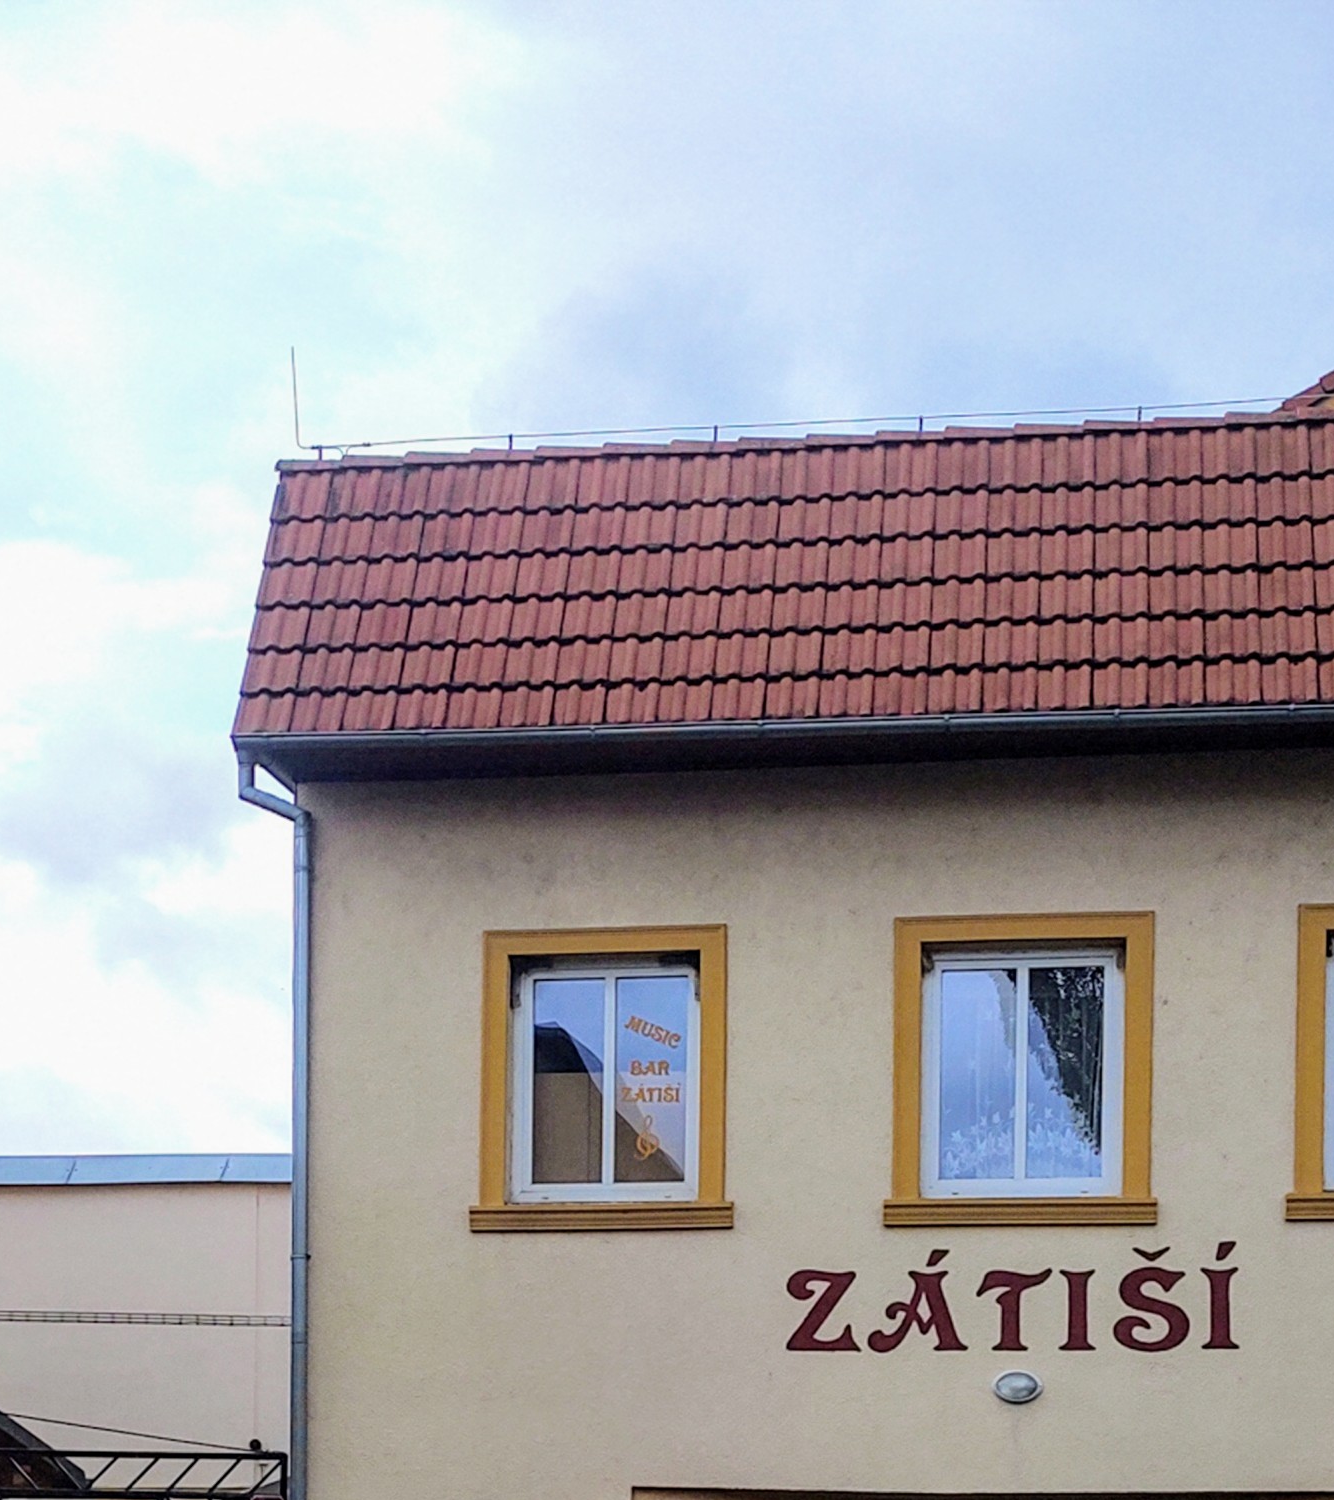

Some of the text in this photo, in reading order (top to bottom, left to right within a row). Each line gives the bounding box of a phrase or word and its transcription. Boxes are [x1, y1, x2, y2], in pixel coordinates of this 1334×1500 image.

[624, 1015, 681, 1049] MUSIC
[630, 1060, 670, 1076] BAR
[785, 1241, 1241, 1353] ZÁTIŠÍ
